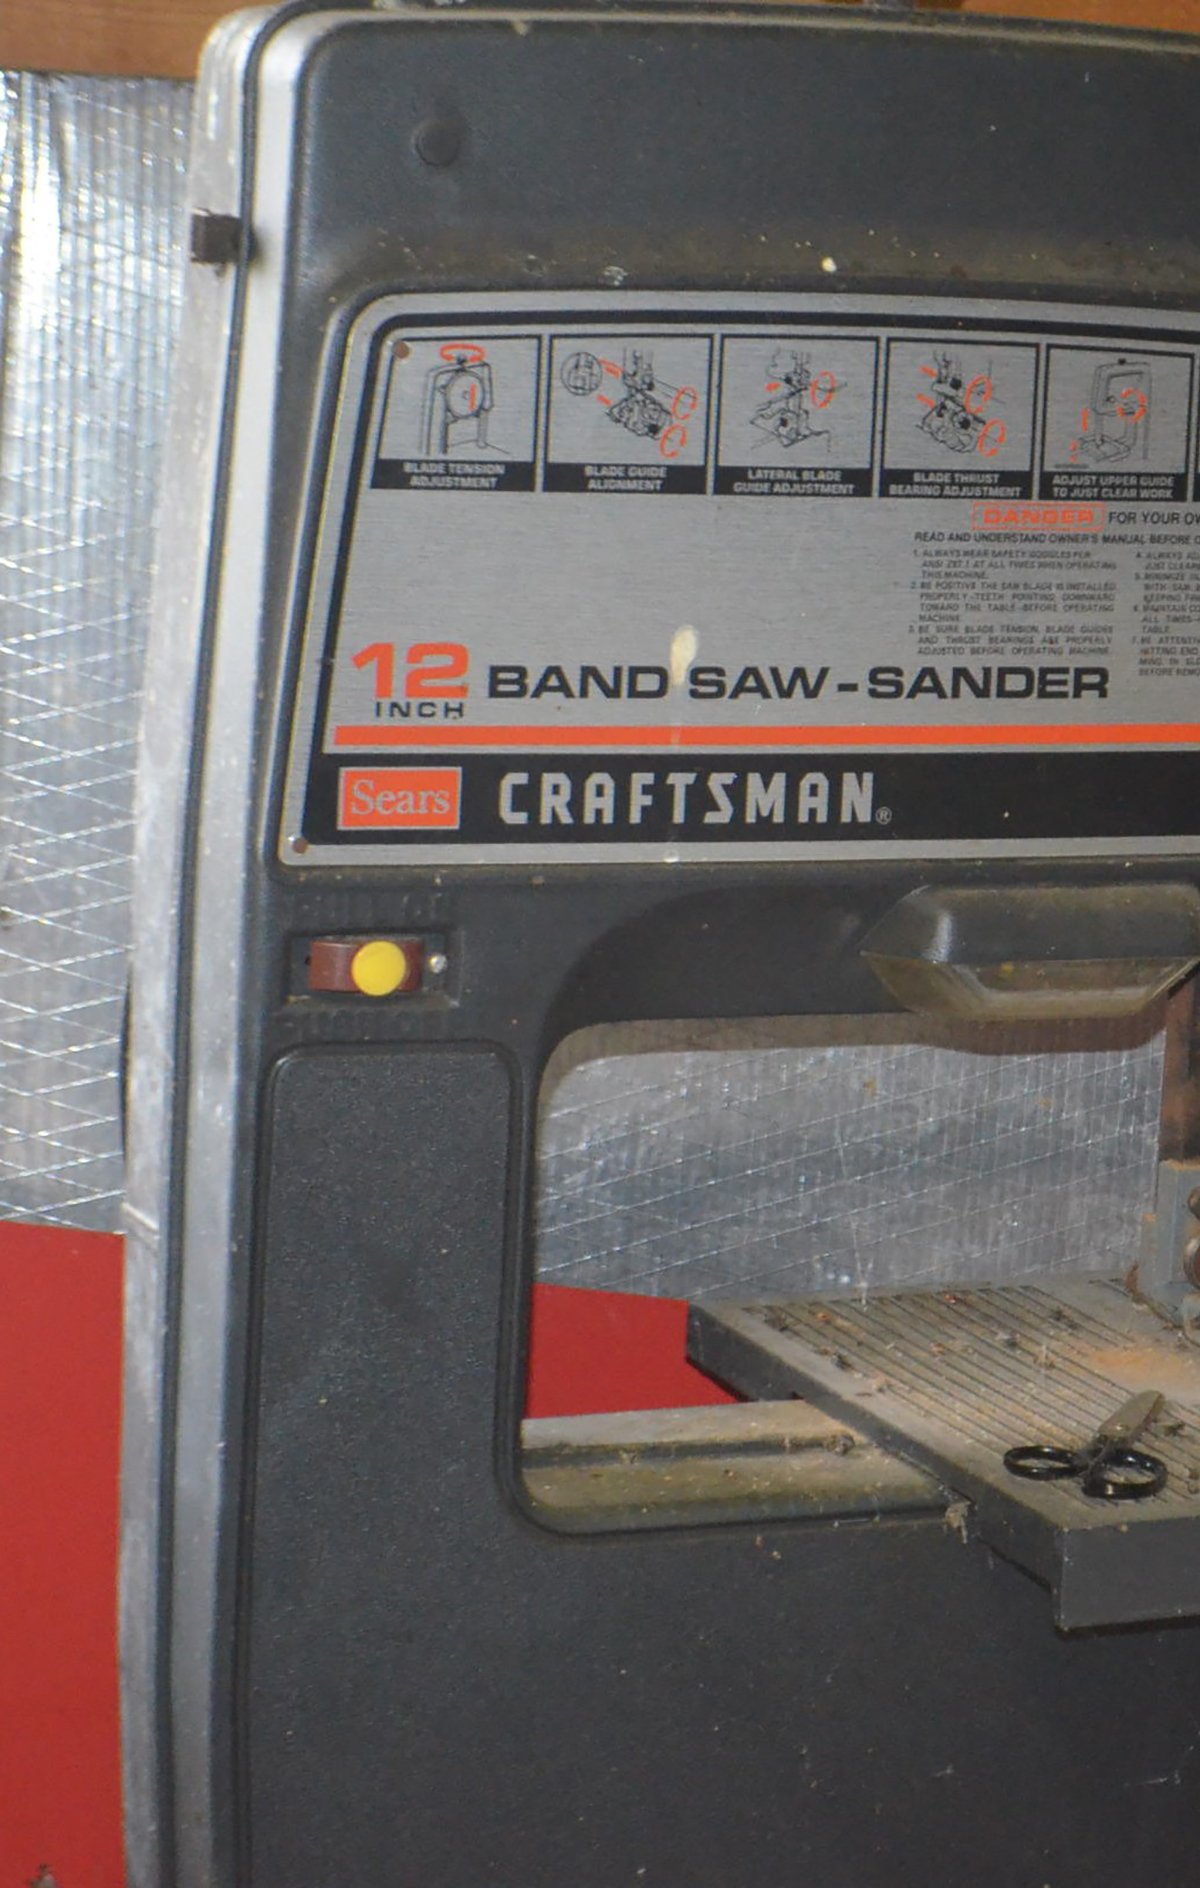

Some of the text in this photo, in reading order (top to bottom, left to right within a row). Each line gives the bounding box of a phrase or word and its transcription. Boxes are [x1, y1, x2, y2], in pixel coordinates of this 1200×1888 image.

[448, 462, 506, 475] TENSION
[583, 465, 668, 478] BLADE GUIDE
[747, 468, 842, 482] LATERAL BLADE
[409, 475, 498, 488] ADJUSTMENT
[913, 471, 1000, 484] BLADE THRUST
[1051, 474, 1176, 487] ADJUST UPPER GUIDE
[587, 479, 664, 491] ALIGNMENT
[733, 481, 855, 495] GUIDE ADJUSTMENT
[888, 483, 1022, 497] BEARING ADJUSTMENT
[1052, 487, 1174, 499] TO JUST CLEAR WORK
[982, 508, 1095, 524] DANGER
[1109, 511, 1137, 525] FOR
[1141, 512, 1181, 525] YOUR
[914, 531, 945, 542] READ
[947, 532, 971, 542] AND
[974, 532, 1048, 544] UNDERSTAND
[1102, 534, 1145, 545] MANUAL
[1149, 534, 1191, 545] BEFORE
[351, 641, 470, 699] 12
[488, 664, 670, 699] BAND
[374, 701, 465, 719] INCH
[350, 778, 451, 816] Sears
